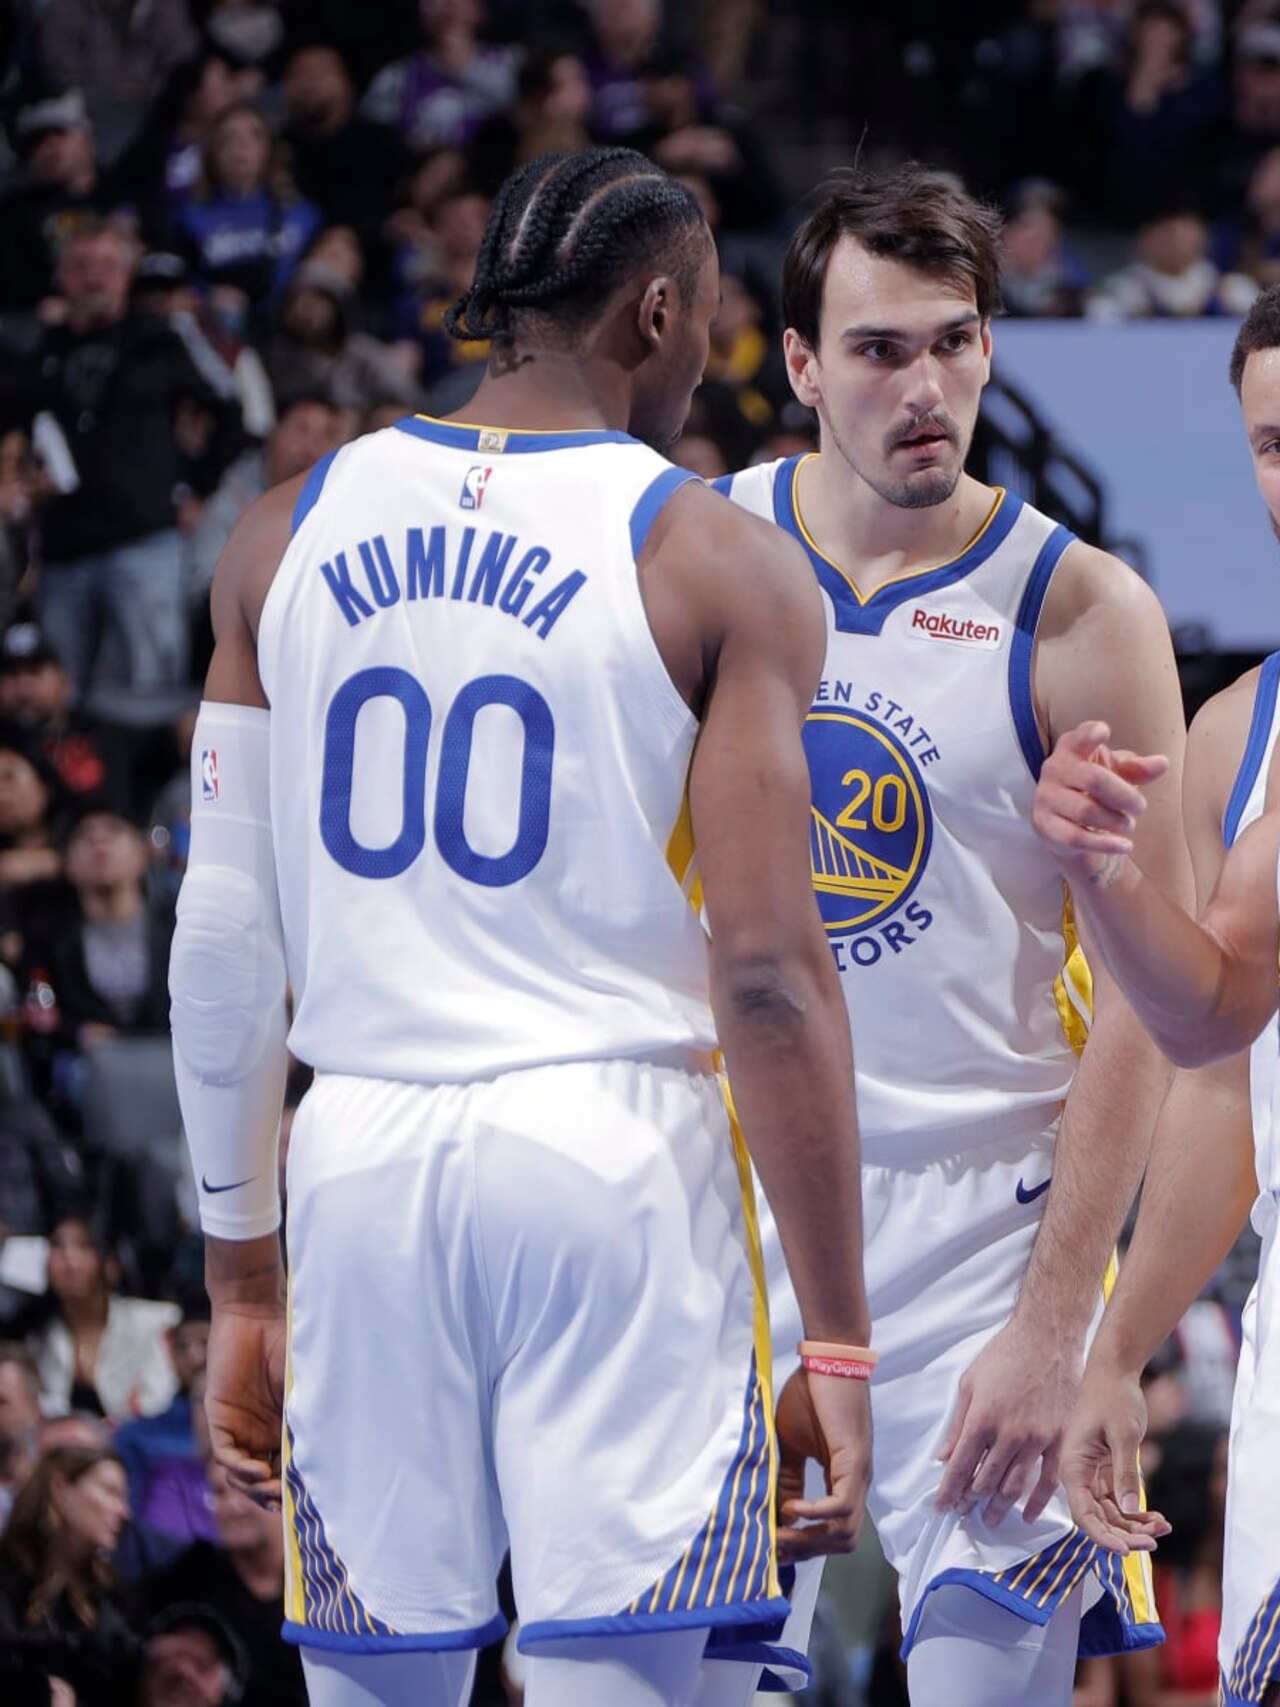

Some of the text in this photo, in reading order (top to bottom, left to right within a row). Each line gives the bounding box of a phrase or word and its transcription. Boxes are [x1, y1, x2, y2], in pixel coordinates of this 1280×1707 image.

[320, 525, 588, 640] KUMINGA
[912, 609, 999, 641] Rakuten
[865, 692, 941, 767] STATE
[319, 665, 555, 888] 00
[836, 768, 907, 832] 20
